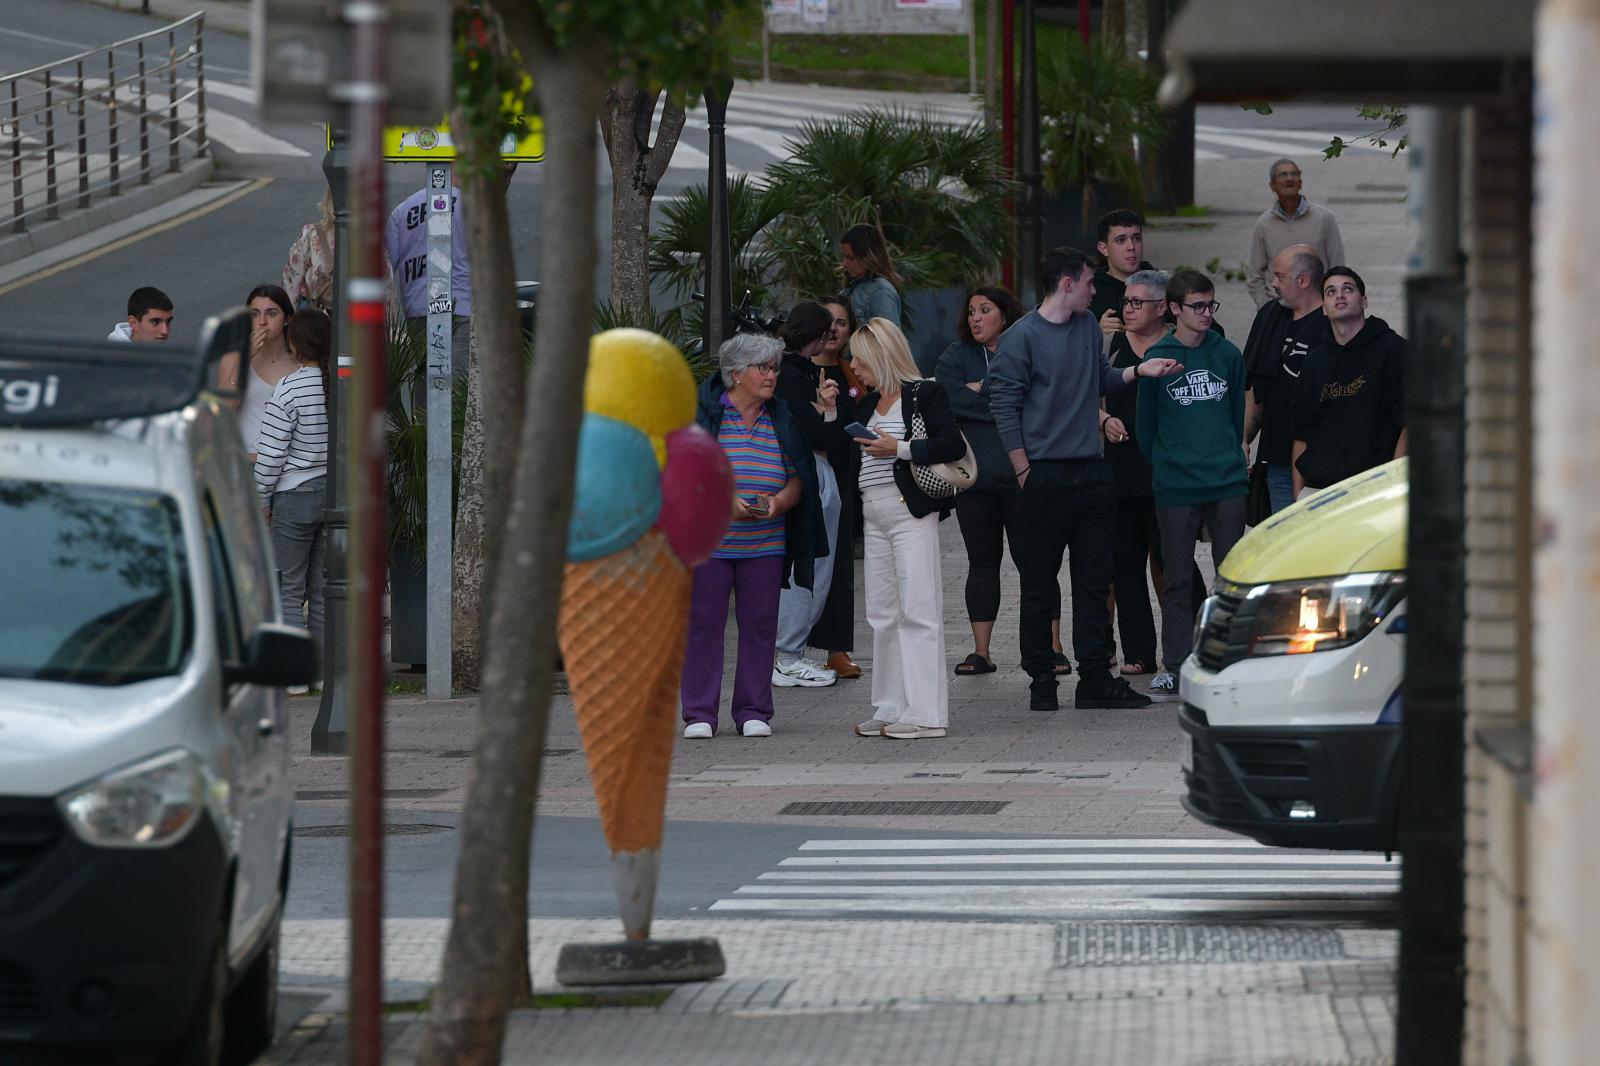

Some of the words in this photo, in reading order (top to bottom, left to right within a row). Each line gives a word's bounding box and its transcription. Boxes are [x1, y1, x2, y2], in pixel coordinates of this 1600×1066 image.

[1186, 371, 1209, 385] VANS
[0, 375, 59, 413] gi
[1190, 382, 1207, 397] THE
